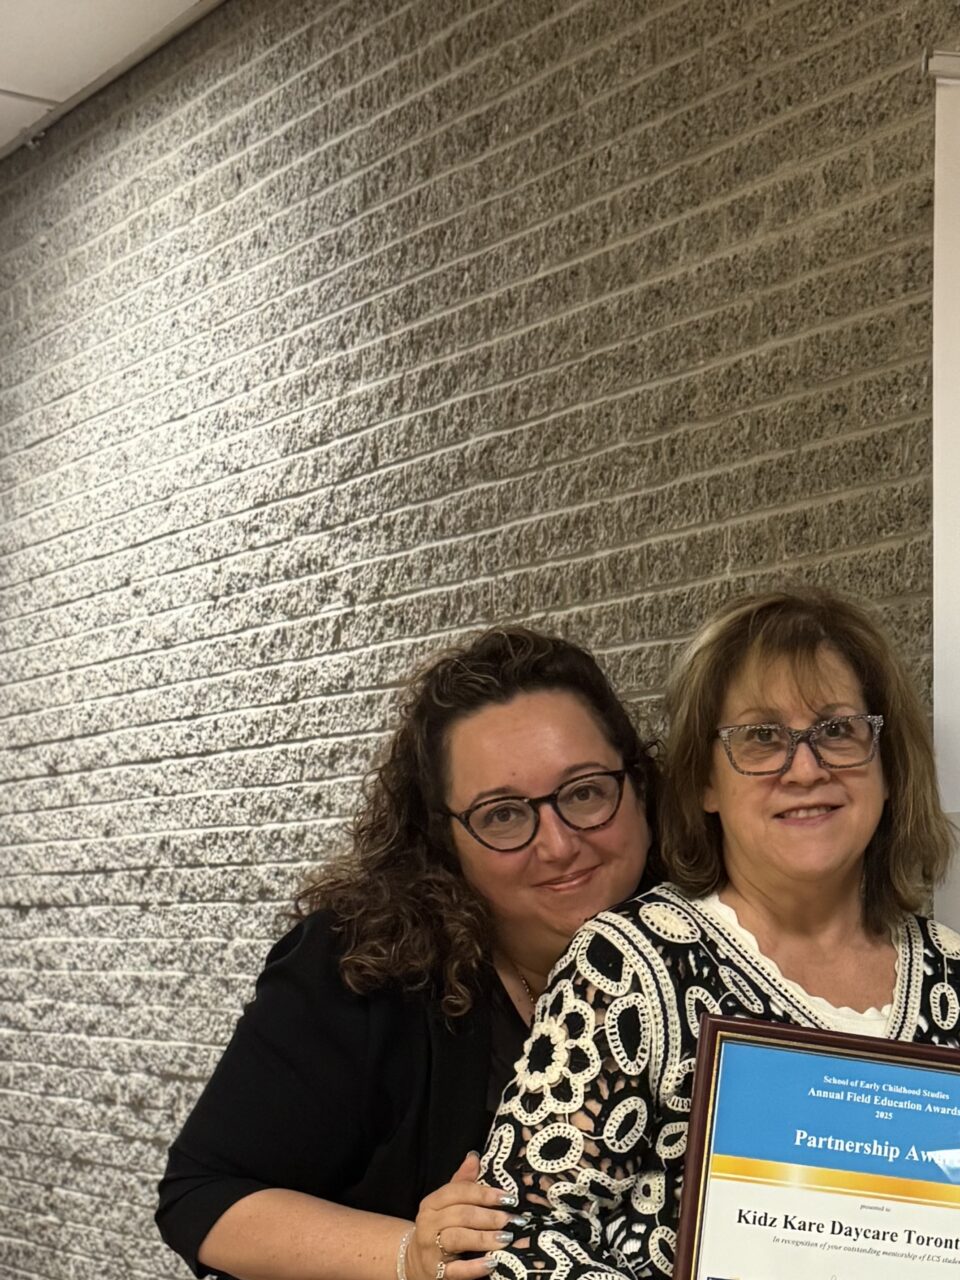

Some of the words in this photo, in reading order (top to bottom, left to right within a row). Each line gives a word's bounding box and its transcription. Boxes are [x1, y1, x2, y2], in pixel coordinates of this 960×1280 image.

[808, 1087, 844, 1100] Annual
[846, 1092, 871, 1104] Field
[873, 1096, 922, 1111] Education
[823, 1075, 849, 1086] School
[859, 1080, 880, 1091] Early
[882, 1084, 921, 1096] Childhood
[922, 1089, 950, 1100] Studies
[874, 1110, 893, 1120] 2025
[794, 1129, 900, 1163] Partnership
[737, 1208, 778, 1228] Kidz
[783, 1214, 825, 1233] Kare
[830, 1220, 899, 1242] Daycare
